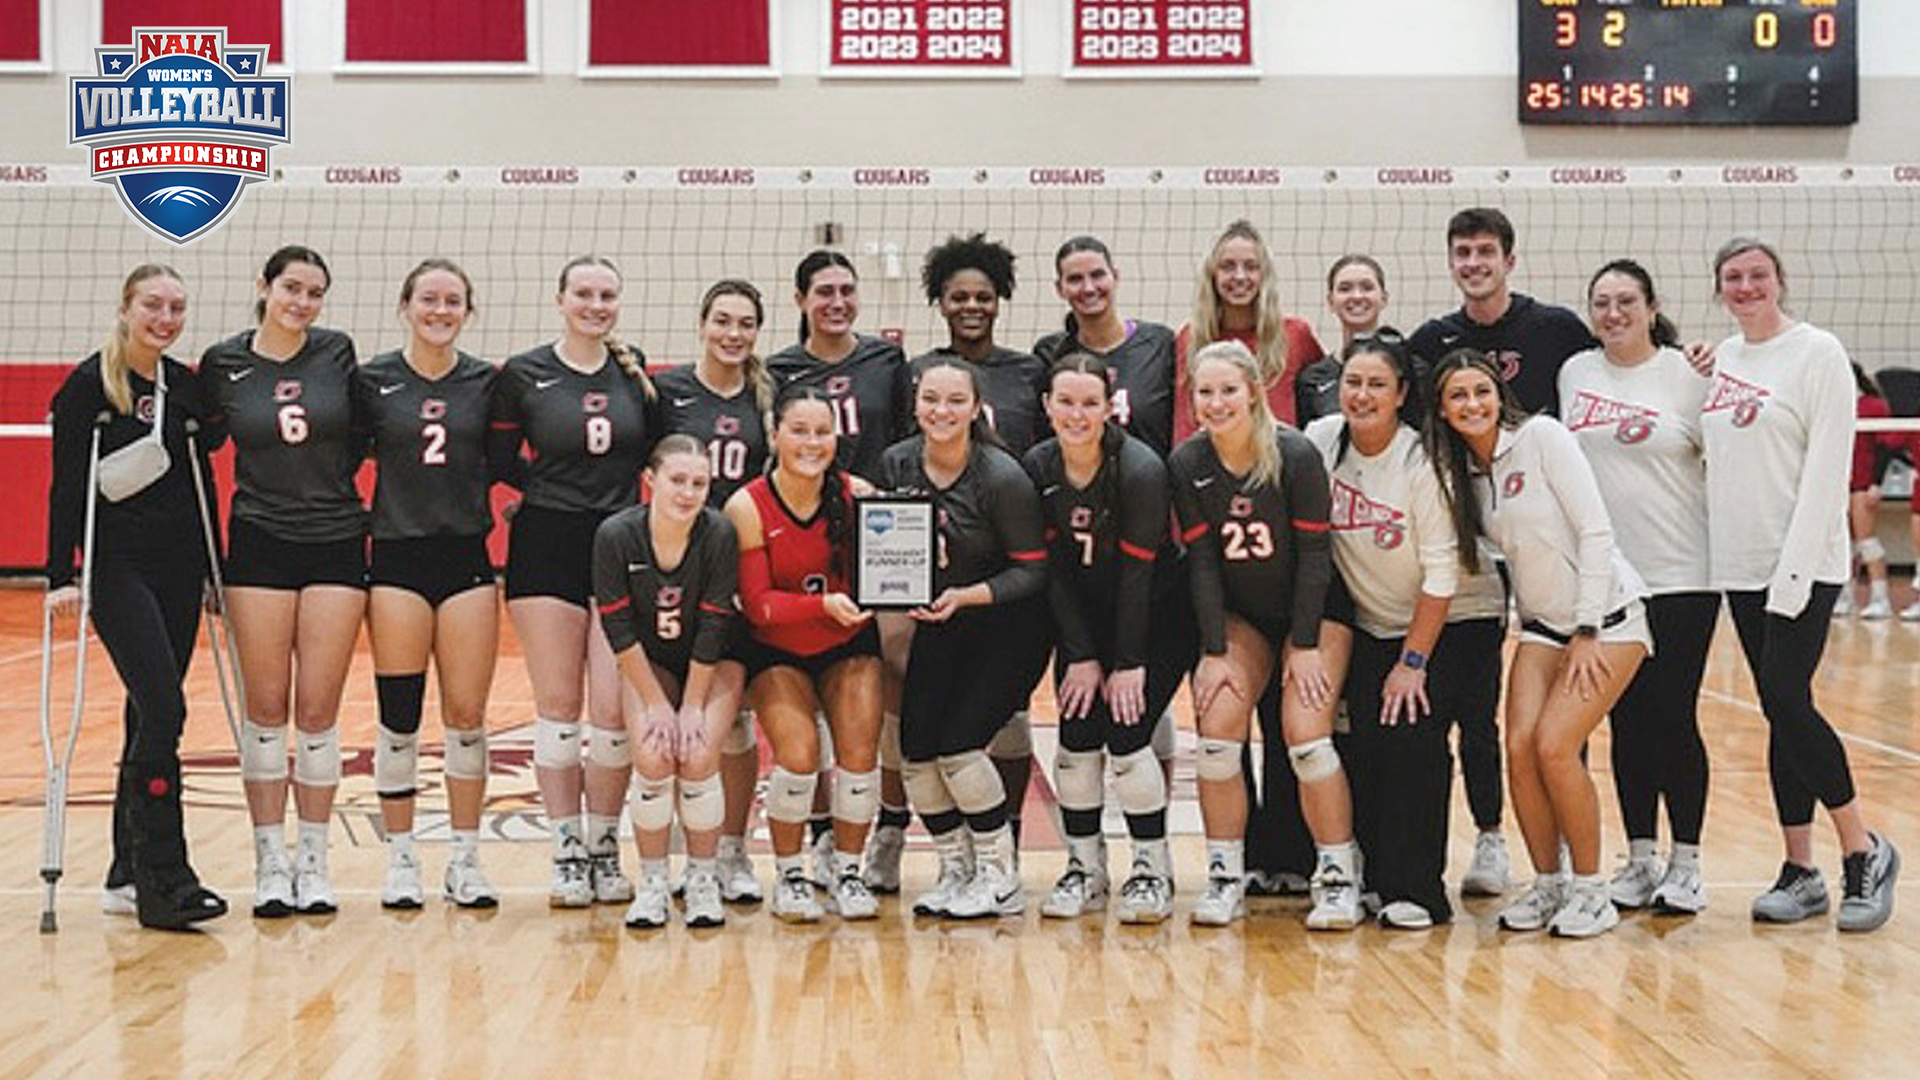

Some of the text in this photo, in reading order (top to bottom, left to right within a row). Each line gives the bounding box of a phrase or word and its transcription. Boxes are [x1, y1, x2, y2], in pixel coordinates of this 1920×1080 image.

[841, 7, 1003, 30] 2021 2022
[1082, 7, 1244, 30] 2021 2022
[1556, 11, 1835, 47] 3 2 0 0
[841, 35, 1002, 59] 2023 2024
[1082, 34, 1242, 59] 2023 2024
[1562, 64, 1820, 81] 1 2 3 4
[325, 167, 401, 183] COUGARS
[501, 169, 578, 184] COUGARS
[679, 169, 755, 184] COUGARS
[854, 169, 930, 184] COUGARS
[1030, 169, 1105, 184] COUGARS
[1204, 169, 1280, 184] COUGARS
[1377, 169, 1453, 184] COUGARS
[1552, 168, 1627, 183] COUGARS
[1722, 167, 1798, 182] COUGARS
[278, 405, 309, 443] 6
[586, 416, 612, 455] 8
[421, 424, 447, 464] 2
[708, 440, 748, 480] 10
[1071, 531, 1093, 567] 7
[1221, 521, 1275, 560] 23
[656, 608, 682, 640] 5
